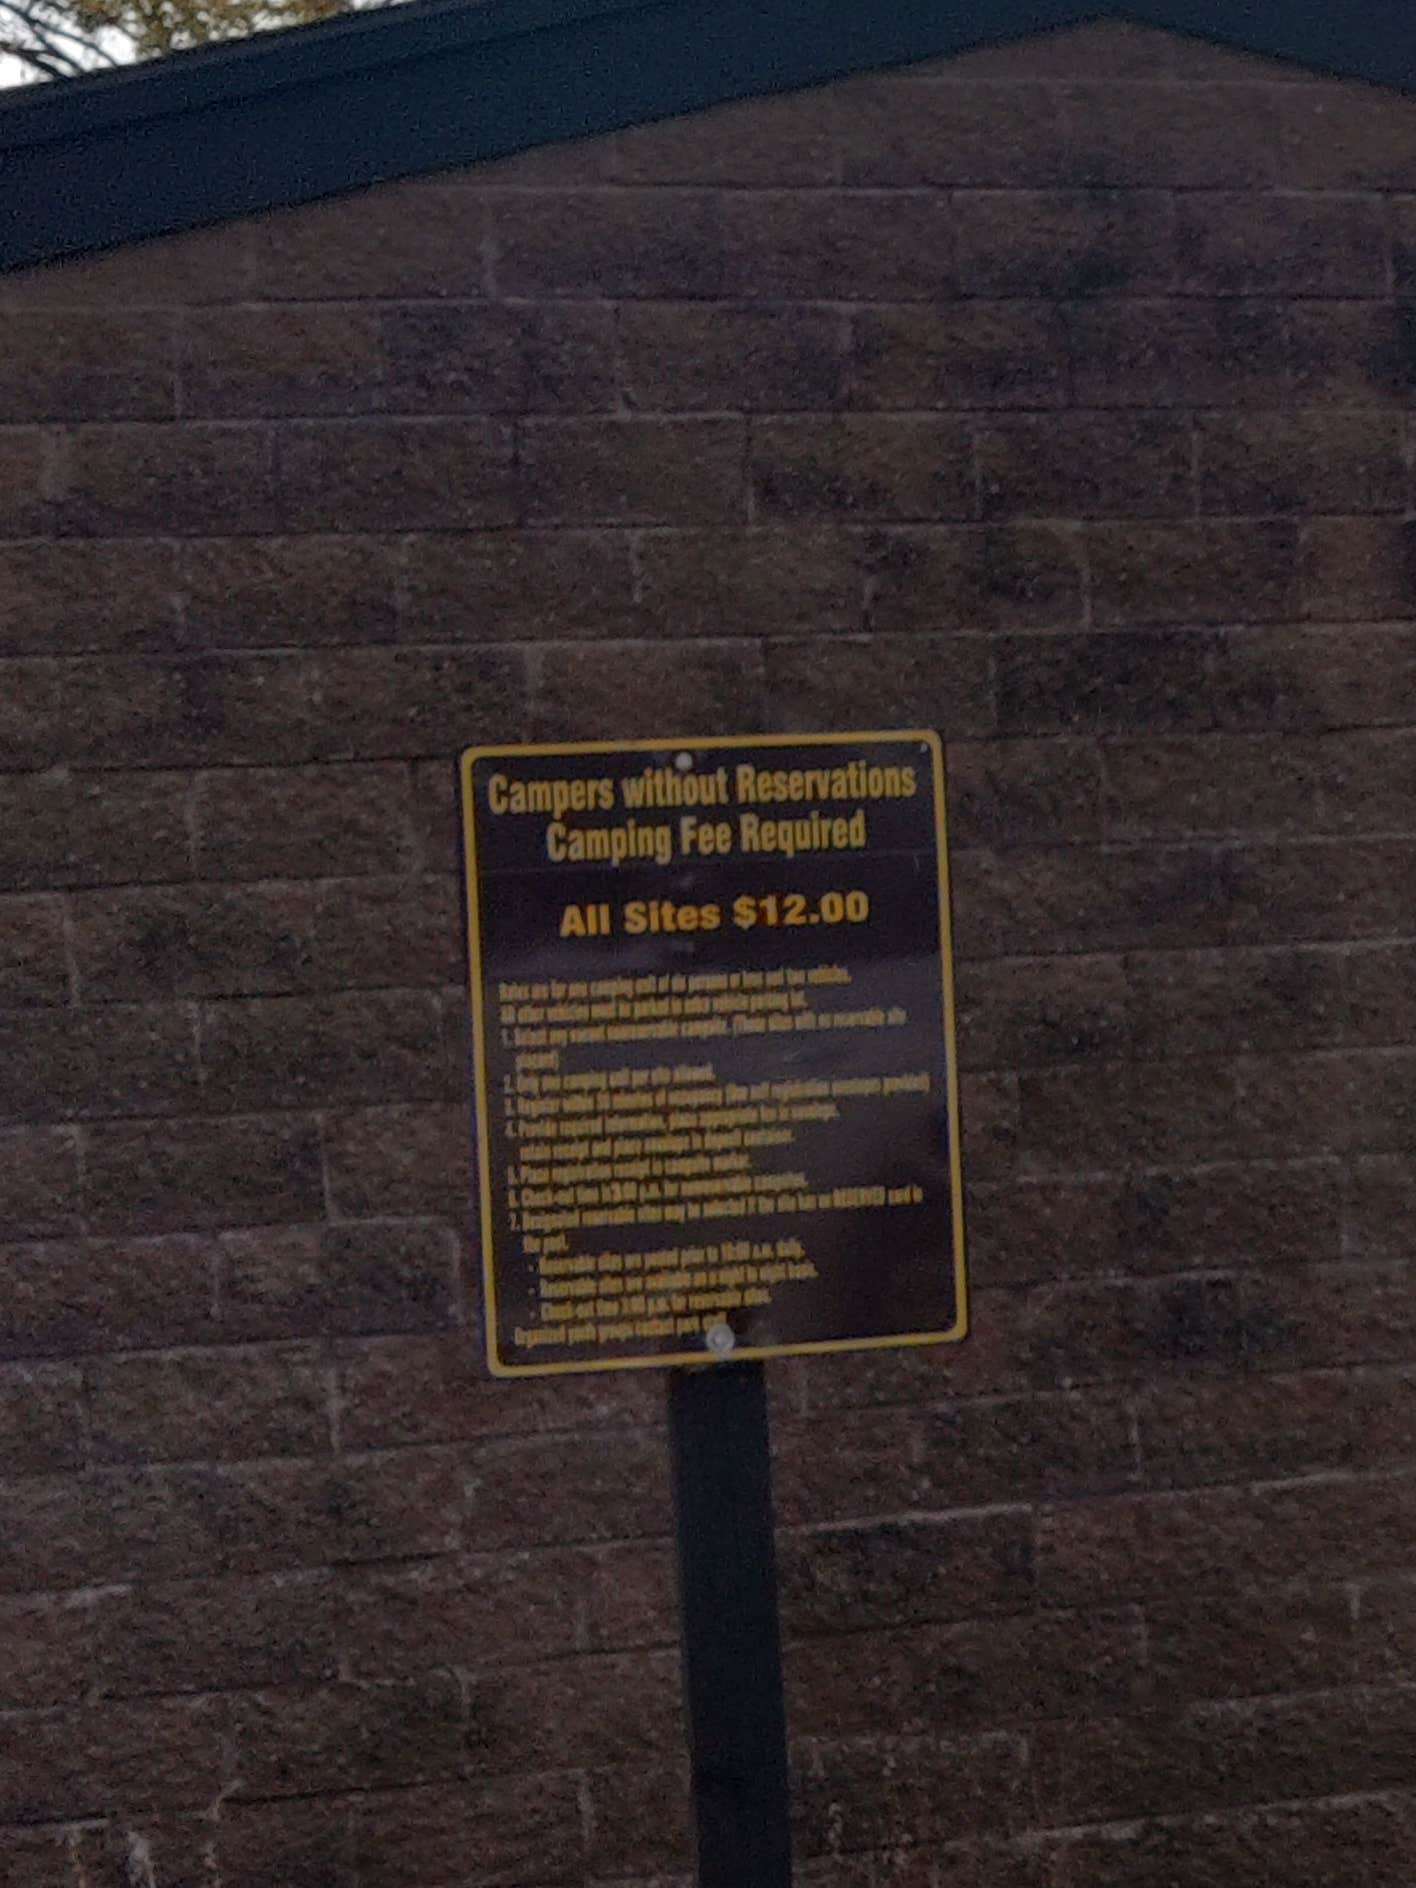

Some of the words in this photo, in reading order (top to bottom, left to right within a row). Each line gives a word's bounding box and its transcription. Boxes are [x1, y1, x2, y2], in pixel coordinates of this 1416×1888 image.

[489, 774, 615, 820] Campers
[624, 767, 728, 808] without
[737, 761, 917, 806] Reservations
[546, 820, 672, 866] Camping
[680, 816, 731, 855] Fee
[740, 810, 866, 859] Required
[560, 903, 609, 938] All
[624, 900, 720, 934] Sites
[733, 891, 869, 930] $12.00
